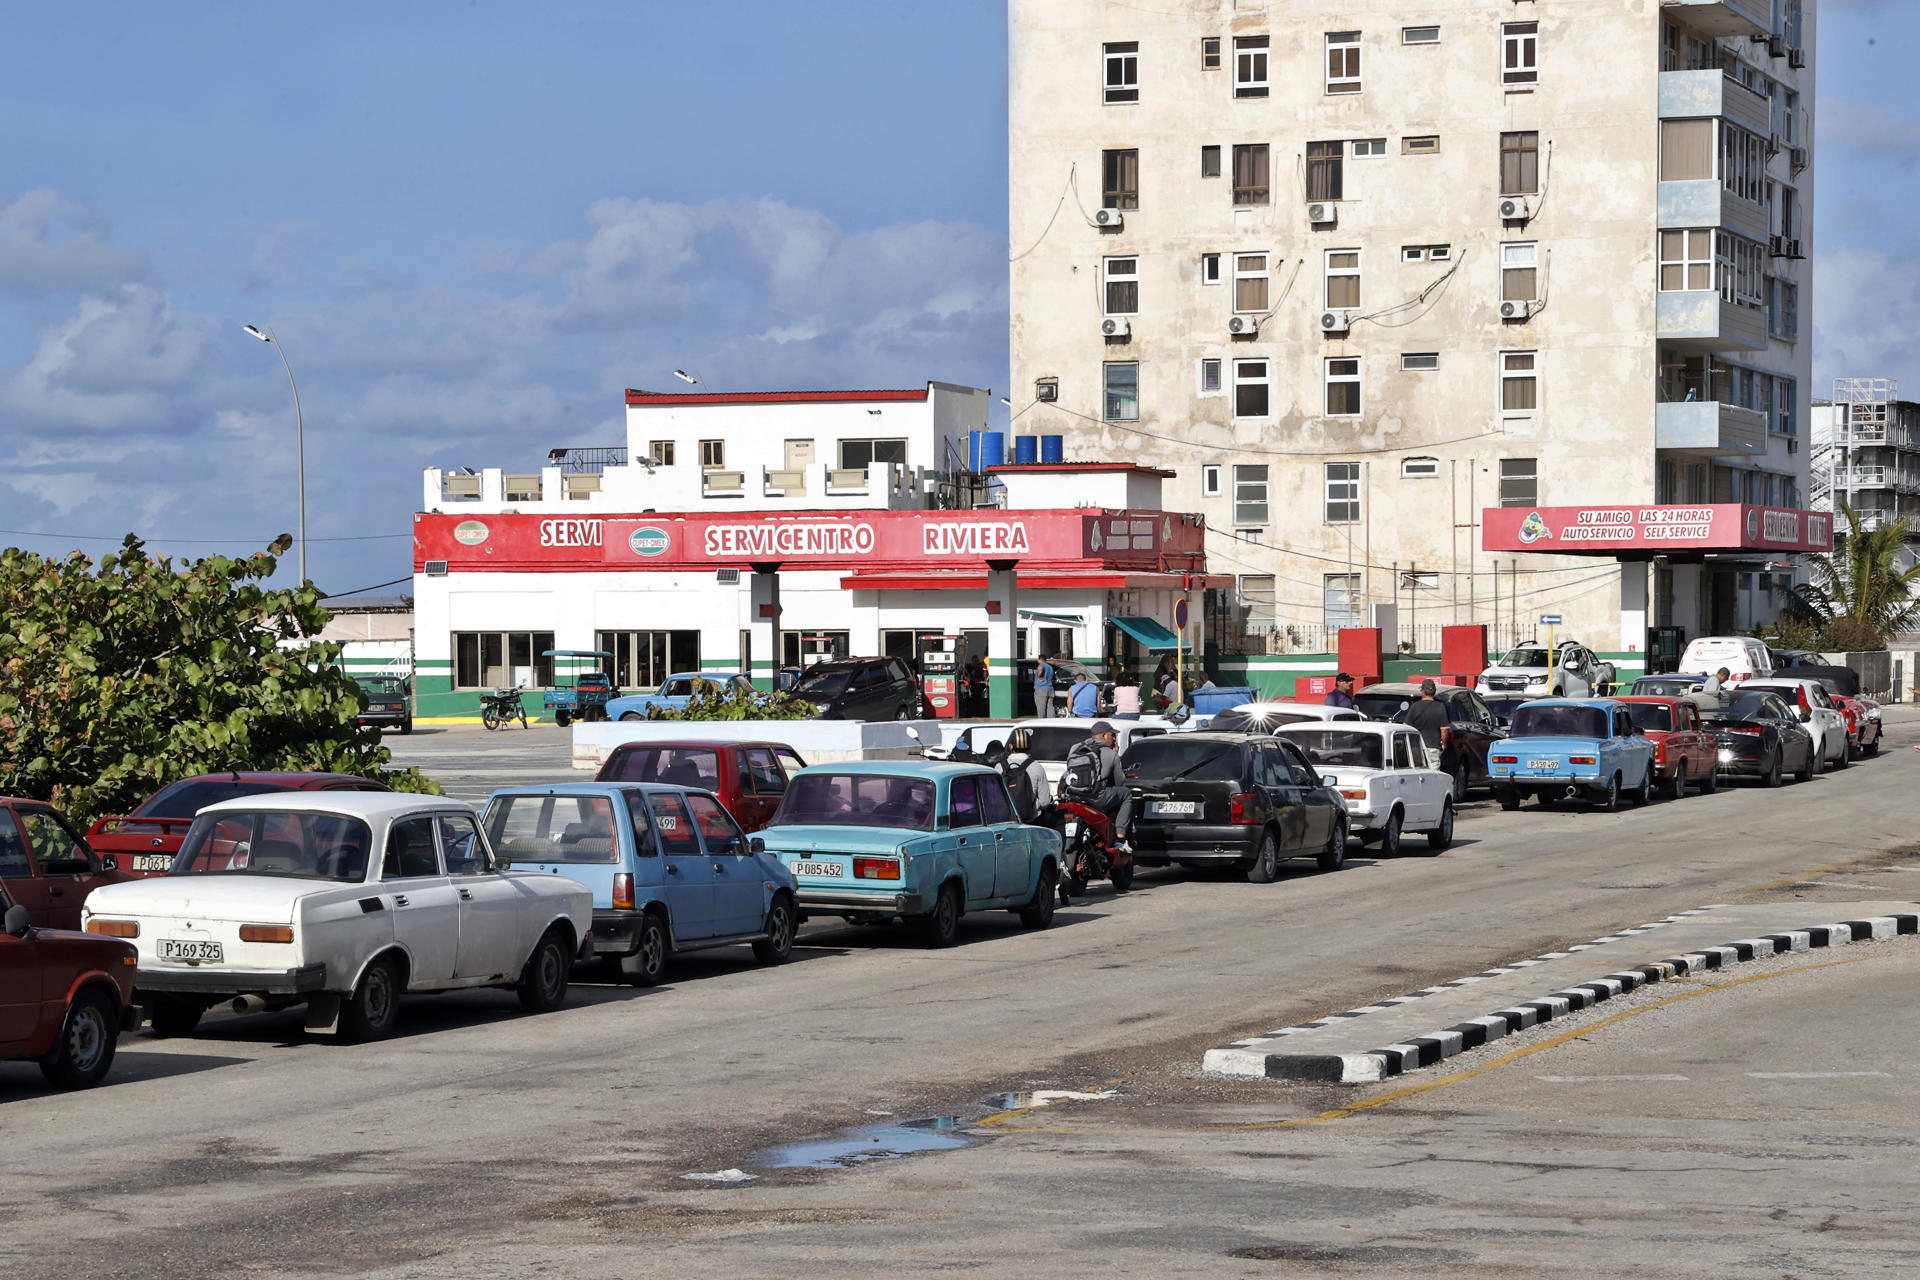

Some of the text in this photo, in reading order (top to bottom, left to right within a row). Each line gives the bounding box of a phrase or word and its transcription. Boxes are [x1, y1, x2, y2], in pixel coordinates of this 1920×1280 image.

[1578, 511, 1631, 523] SU AMIGO
[1639, 510, 1713, 523] LAS 24 HORAS
[924, 523, 1029, 553] RIVIERA
[1645, 526, 1709, 538] SELF SERVICE
[705, 524, 874, 555] SERVICENTRO
